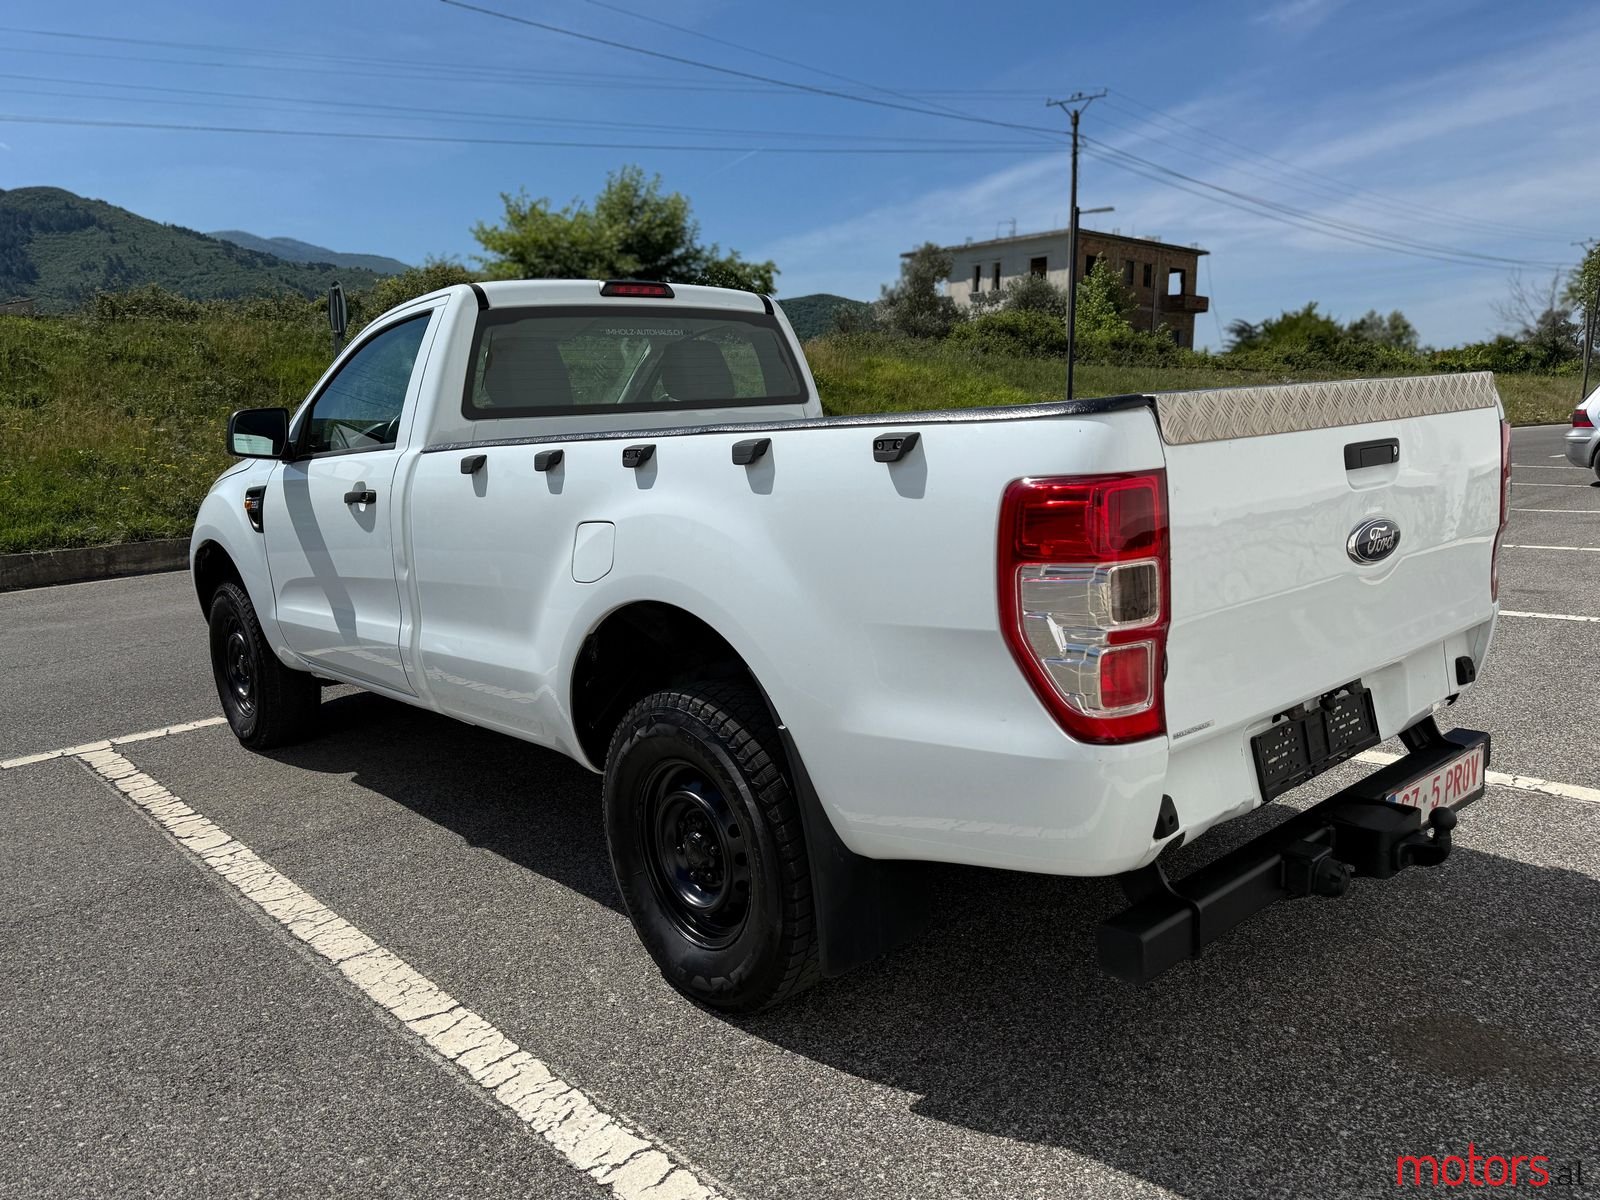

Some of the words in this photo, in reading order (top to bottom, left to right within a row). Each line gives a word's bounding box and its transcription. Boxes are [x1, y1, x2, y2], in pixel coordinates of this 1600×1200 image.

[1367, 526, 1395, 554] Ford
[1431, 775, 1441, 809] 5
[1445, 753, 1479, 804] PROV
